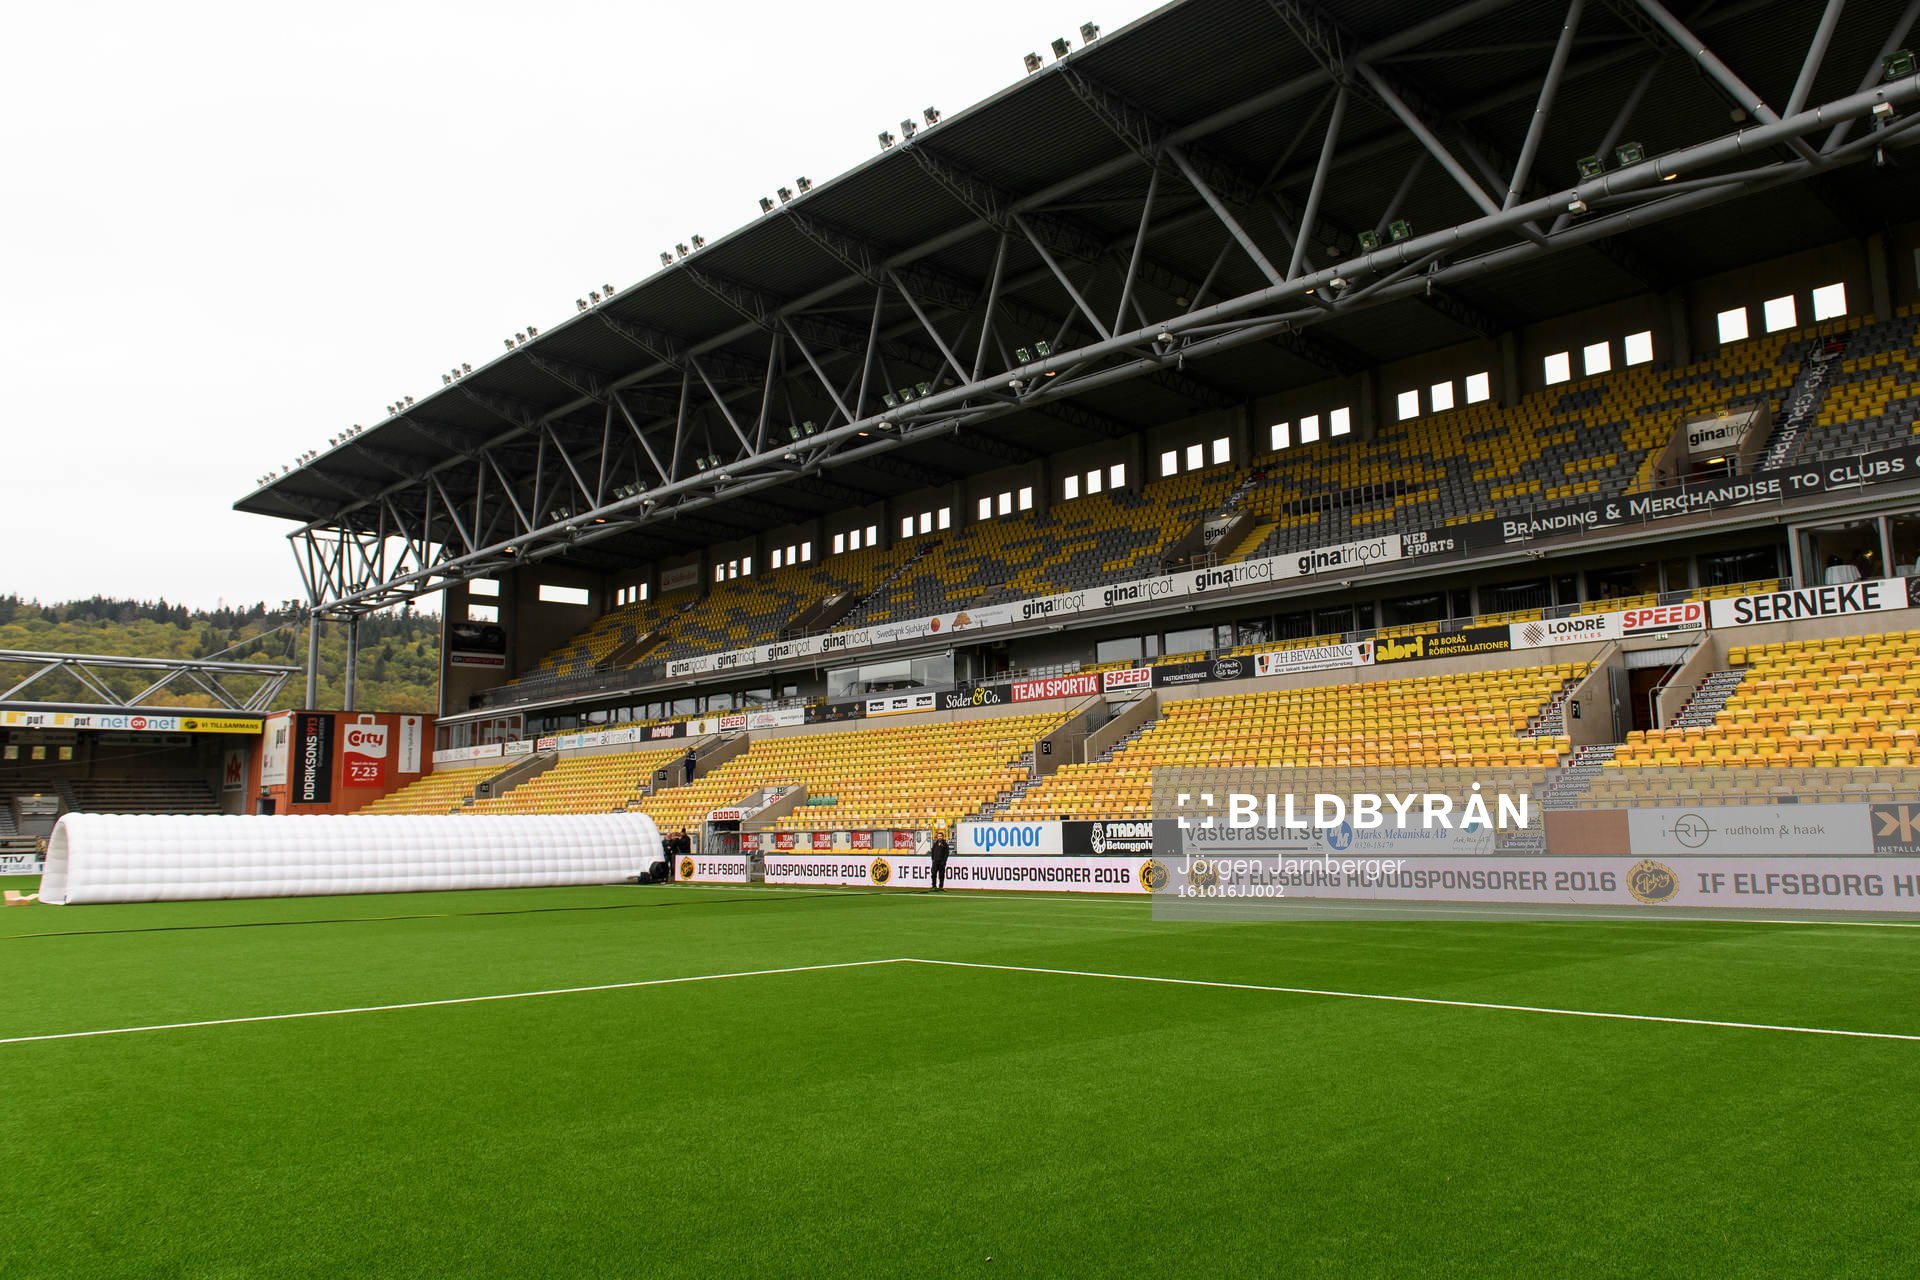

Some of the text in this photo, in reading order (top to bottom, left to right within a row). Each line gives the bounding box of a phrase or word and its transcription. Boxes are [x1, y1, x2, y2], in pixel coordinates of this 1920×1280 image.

[1605, 503, 1621, 520] &
[1789, 472, 1820, 489] TO
[1829, 457, 1905, 483] CLUBS
[1402, 532, 1428, 546] NEB
[1407, 538, 1454, 556] SPORTS
[1298, 538, 1388, 575] ginatricot
[1195, 559, 1274, 591] ginatricot
[1104, 576, 1173, 606] ginatricot
[1023, 591, 1085, 619] ginatricot
[1734, 582, 1882, 624] SERNEKE
[1548, 615, 1605, 635] LONDRÉ
[1623, 604, 1701, 629] SPEED
[1428, 634, 1466, 647] AB BORÅS
[1553, 632, 1602, 642] TEXTILES
[1274, 645, 1353, 664] 7H BEVAKNING
[1428, 641, 1509, 656] RÖRINSTALLATIONER
[1106, 668, 1150, 685] SPEED
[1013, 675, 1097, 700] TEAM SPORTIA
[210, 721, 259, 730] TILLSAMMANS
[721, 715, 745, 727] SPEED
[348, 730, 384, 746] City
[1042, 743, 1051, 753] E1
[351, 767, 378, 777] 7-23
[973, 826, 1042, 852] uponor
[1355, 828, 1447, 840] Marks Mekaniska AB
[1724, 823, 1826, 837] rudholm & haak
[698, 863, 747, 876] IF ELFSBOR
[841, 864, 867, 878] 2016
[898, 865, 910, 879] IF
[972, 867, 1091, 883] HUVUDSPONSORER
[1094, 868, 1130, 884] 2016
[1250, 869, 1341, 887] ELFSBORG
[1555, 871, 1617, 892] 2016
[1698, 873, 1920, 897] IF ELFSBORG H
